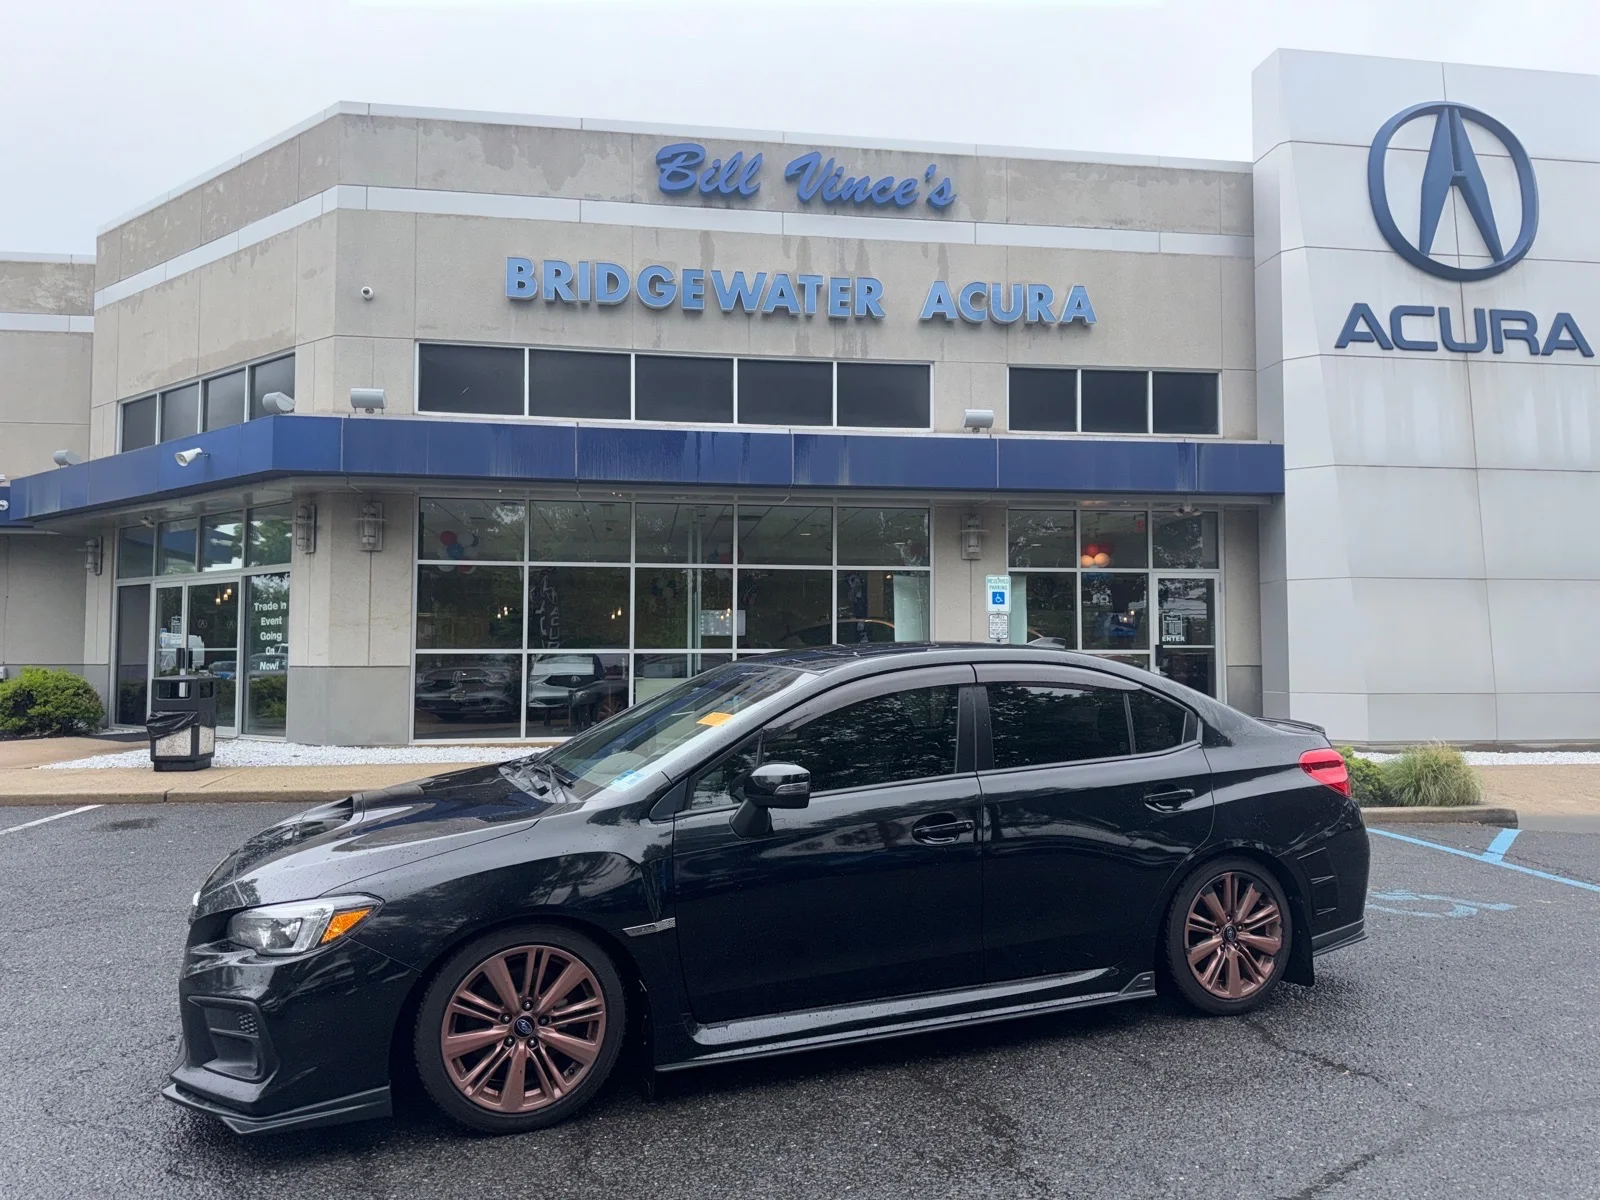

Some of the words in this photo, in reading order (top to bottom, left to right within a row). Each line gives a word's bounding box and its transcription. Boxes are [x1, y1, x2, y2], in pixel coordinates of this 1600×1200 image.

[655, 142, 763, 199] Bill
[785, 151, 957, 209] Vince's
[506, 256, 886, 319] BRIDGEWATER
[919, 280, 1096, 325] ACURA
[1334, 302, 1595, 358] ACURA
[254, 602, 278, 611] Trade
[260, 616, 282, 626] Event
[260, 632, 282, 641] Going
[265, 646, 275, 655] On
[260, 661, 279, 671] Now!
